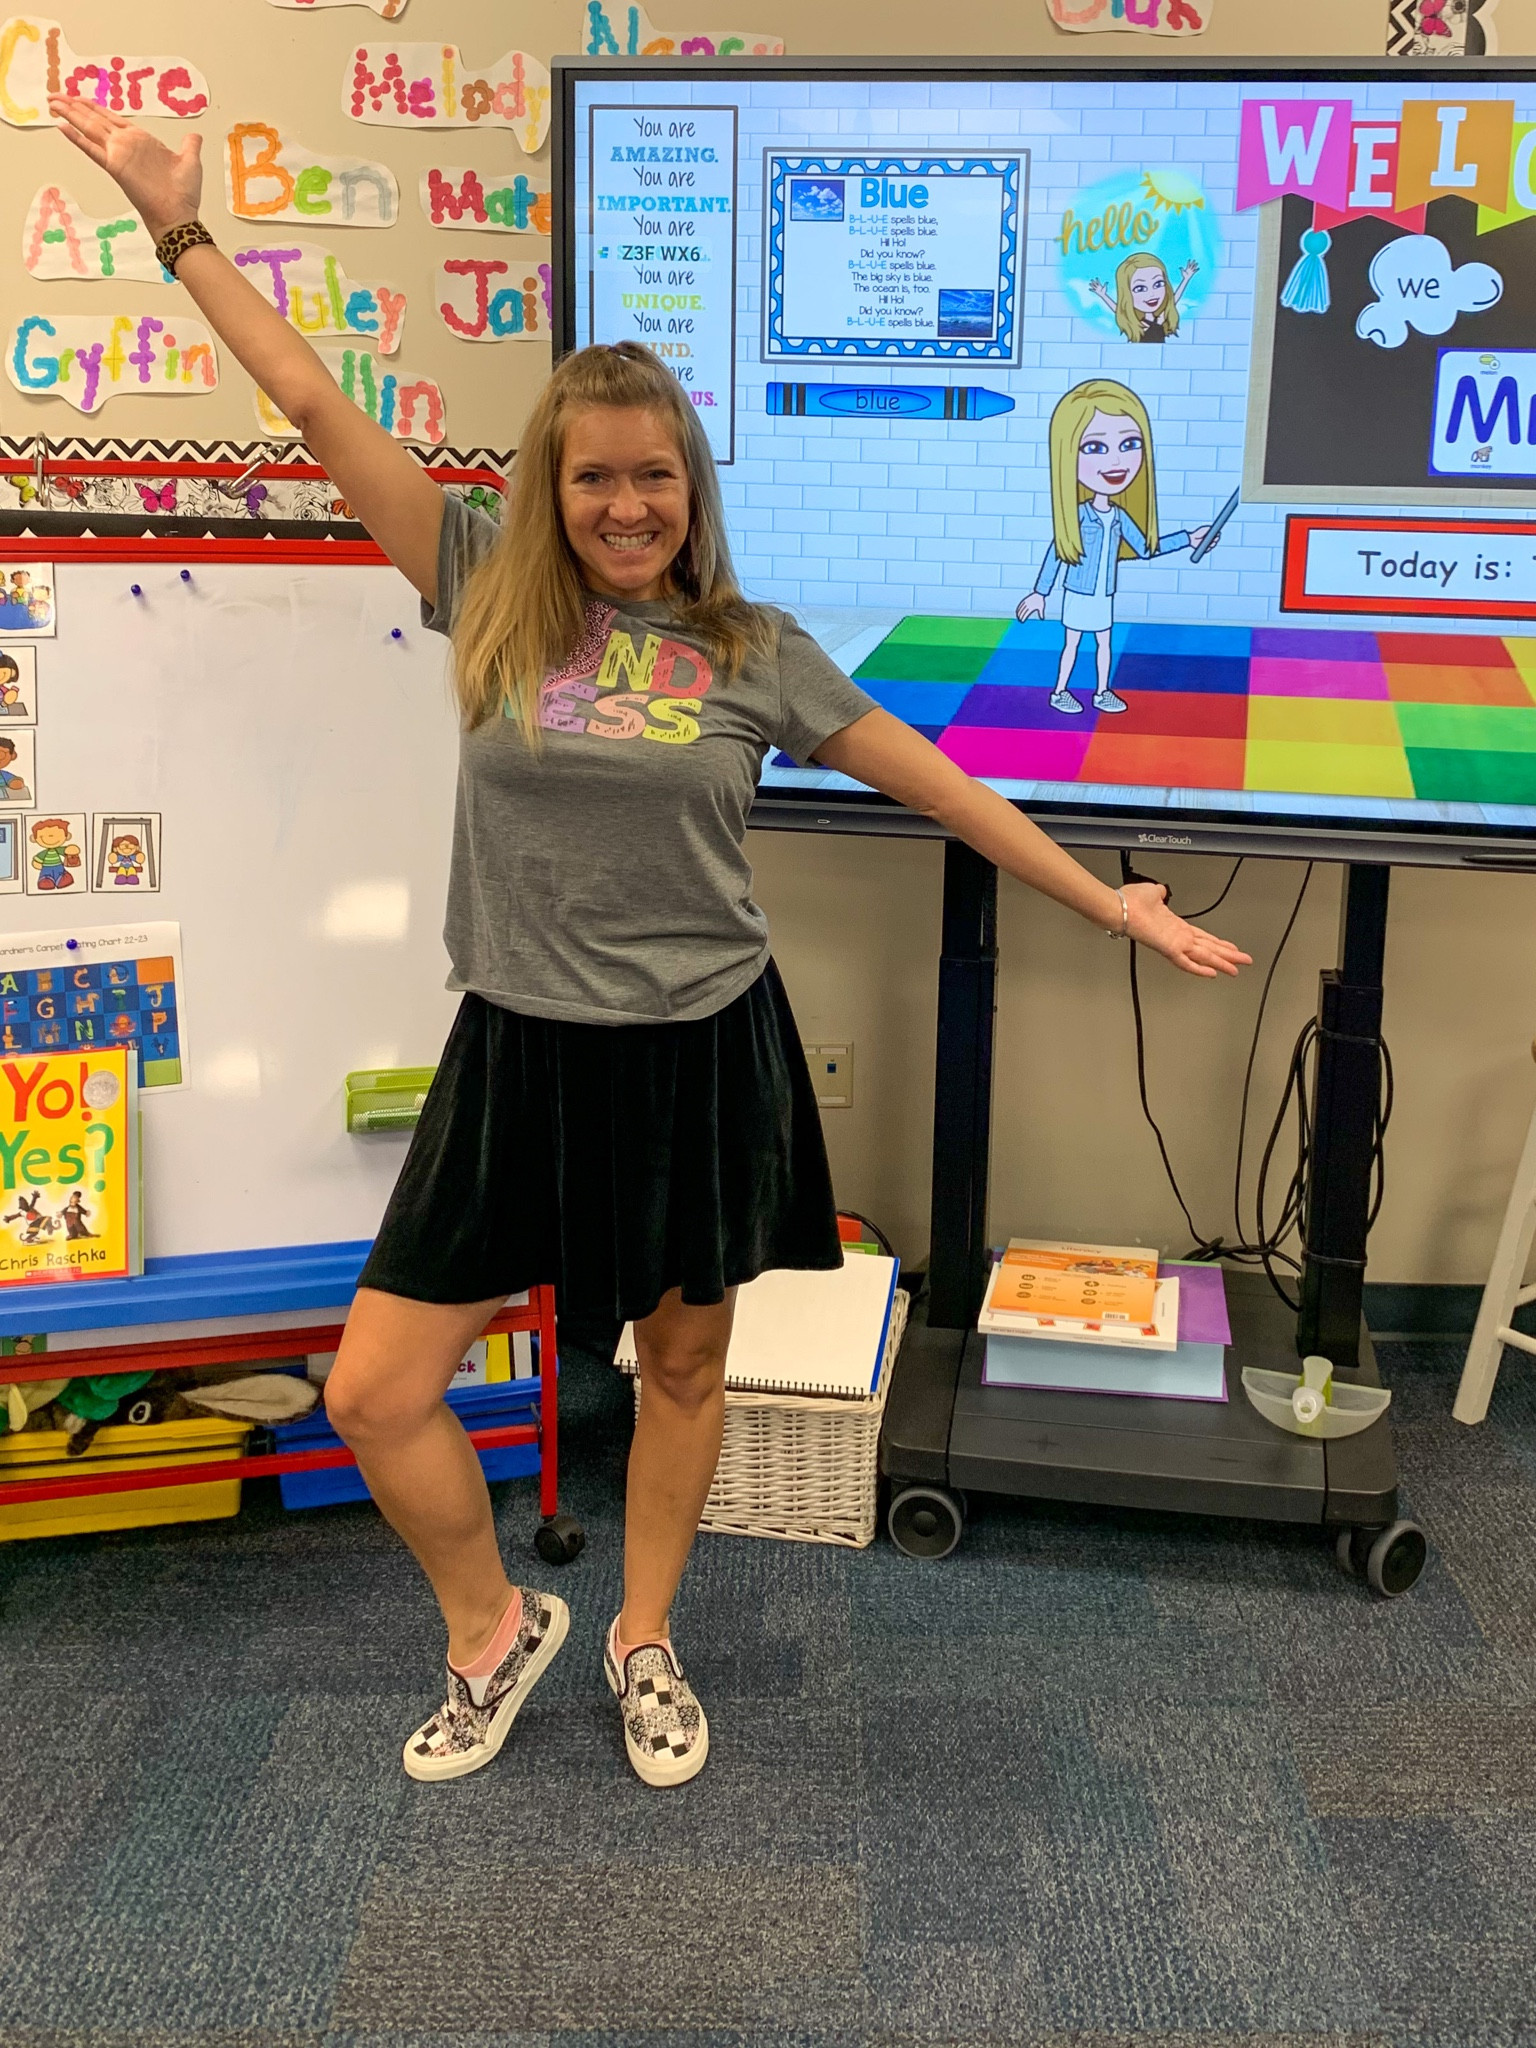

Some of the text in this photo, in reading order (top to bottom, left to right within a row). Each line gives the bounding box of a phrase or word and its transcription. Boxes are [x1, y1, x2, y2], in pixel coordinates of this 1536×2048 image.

[0, 19, 208, 124] Claire
[351, 45, 549, 151] Melody
[633, 116, 695, 138] You are
[610, 146, 719, 163] AMAZING.
[228, 122, 392, 219] Ben
[633, 165, 695, 188] You are
[597, 195, 731, 213] IMPORTANT.
[861, 177, 929, 209] Blue
[633, 214, 695, 237] You are
[890, 226, 915, 237] spells
[891, 215, 915, 226] spells
[1055, 202, 1160, 256] hello
[622, 245, 701, 262] Z3F WX6
[860, 249, 926, 260] Did you know?
[633, 264, 695, 286] You are
[851, 271, 868, 281] The
[870, 272, 883, 283] big
[885, 272, 901, 283] sky
[903, 273, 911, 281] is
[889, 261, 914, 271] spells
[853, 283, 869, 292] The
[872, 285, 900, 293] ocean
[1397, 273, 1441, 301] we
[621, 293, 706, 312] UNIQUE.
[859, 306, 924, 317] Did you know?
[633, 311, 695, 334] You are
[888, 318, 912, 328] spells
[642, 342, 694, 358] IND.
[13, 316, 217, 410] Gryffin
[856, 389, 901, 411] blue
[1357, 550, 1511, 588] Today is:
[505, 679, 703, 745] ESS
[36, 943, 64, 953] Carpet
[76, 940, 97, 949] ating
[98, 937, 121, 947] Chart
[124, 934, 148, 944] 22-23
[73, 967, 91, 989] C
[37, 995, 55, 1019] G
[145, 984, 164, 1008] J
[74, 1019, 95, 1041] N
[151, 1011, 168, 1033] P
[1, 1061, 93, 1122] Yo!
[0, 1122, 114, 1193] Yes?
[0, 1248, 106, 1271] Chris Raschka
